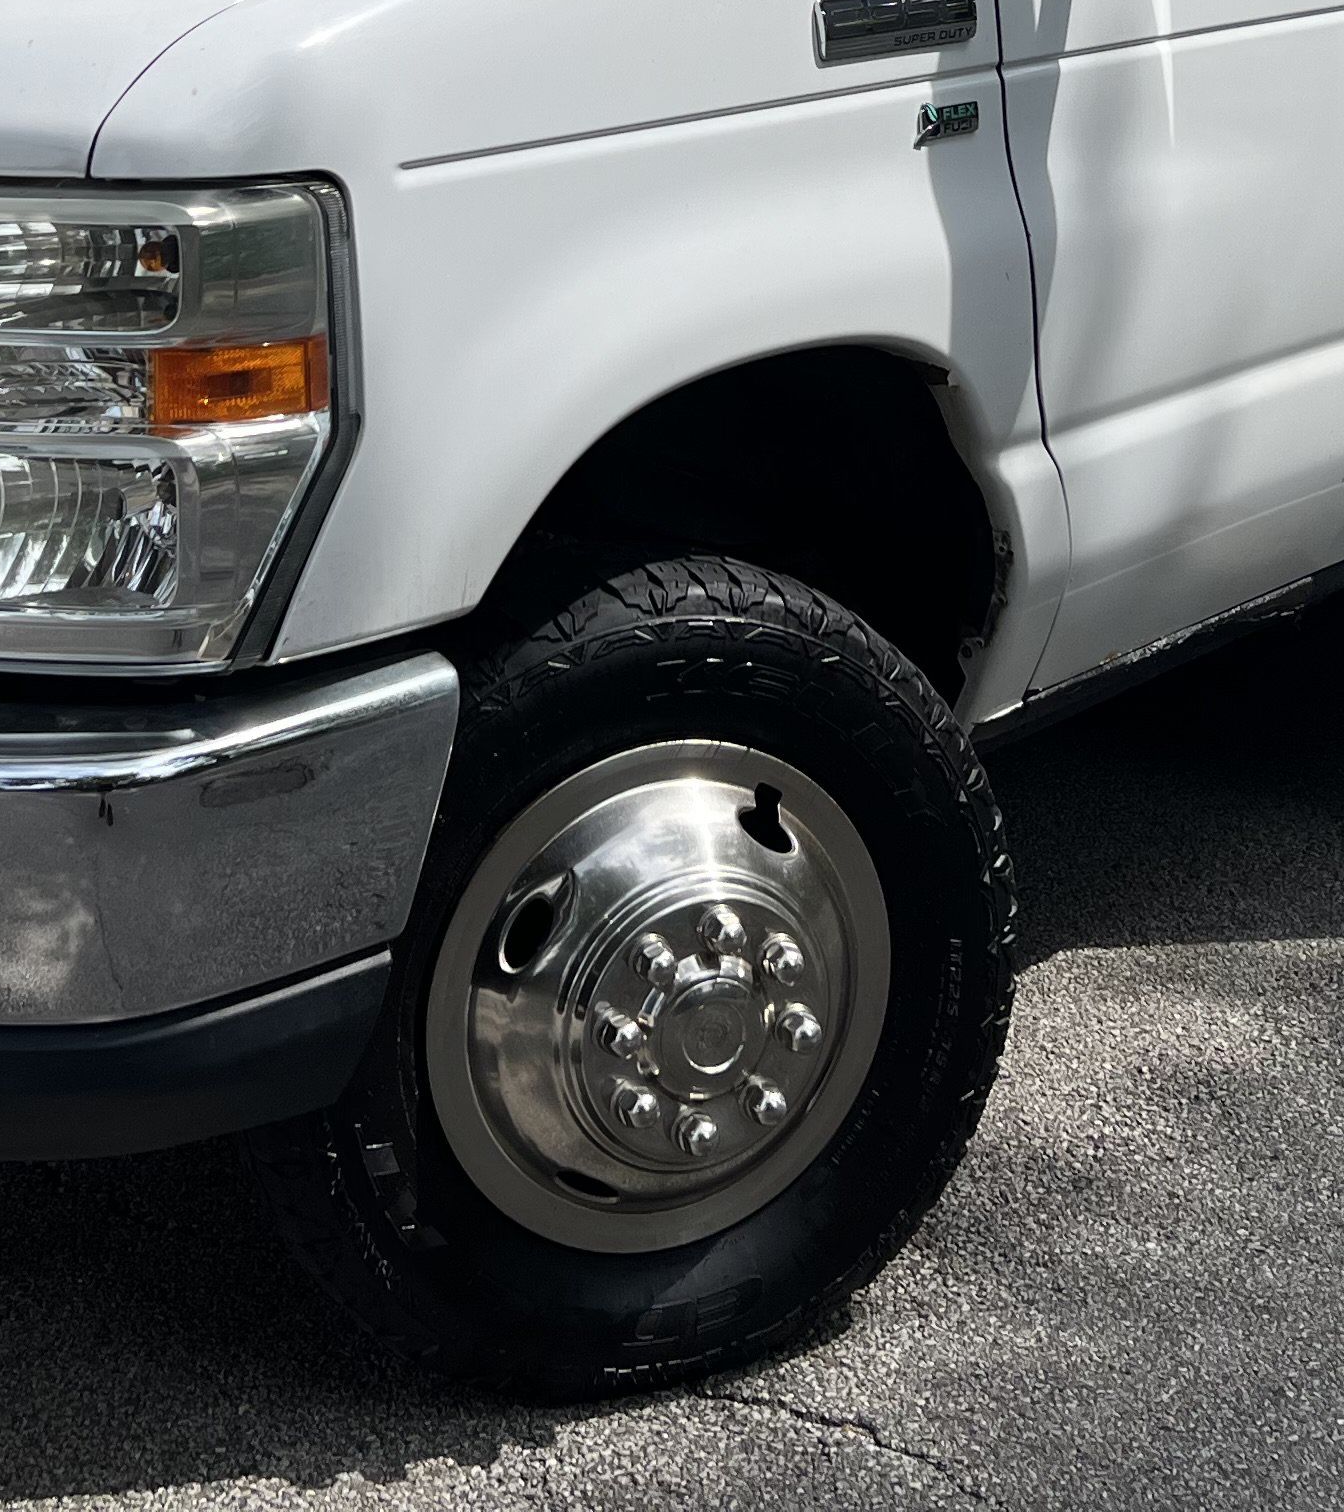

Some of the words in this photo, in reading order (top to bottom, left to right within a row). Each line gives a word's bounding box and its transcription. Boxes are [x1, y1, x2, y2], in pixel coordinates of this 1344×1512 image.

[894, 32, 935, 46] SUPER
[939, 27, 972, 39] DUTY
[943, 104, 975, 120] FLEX
